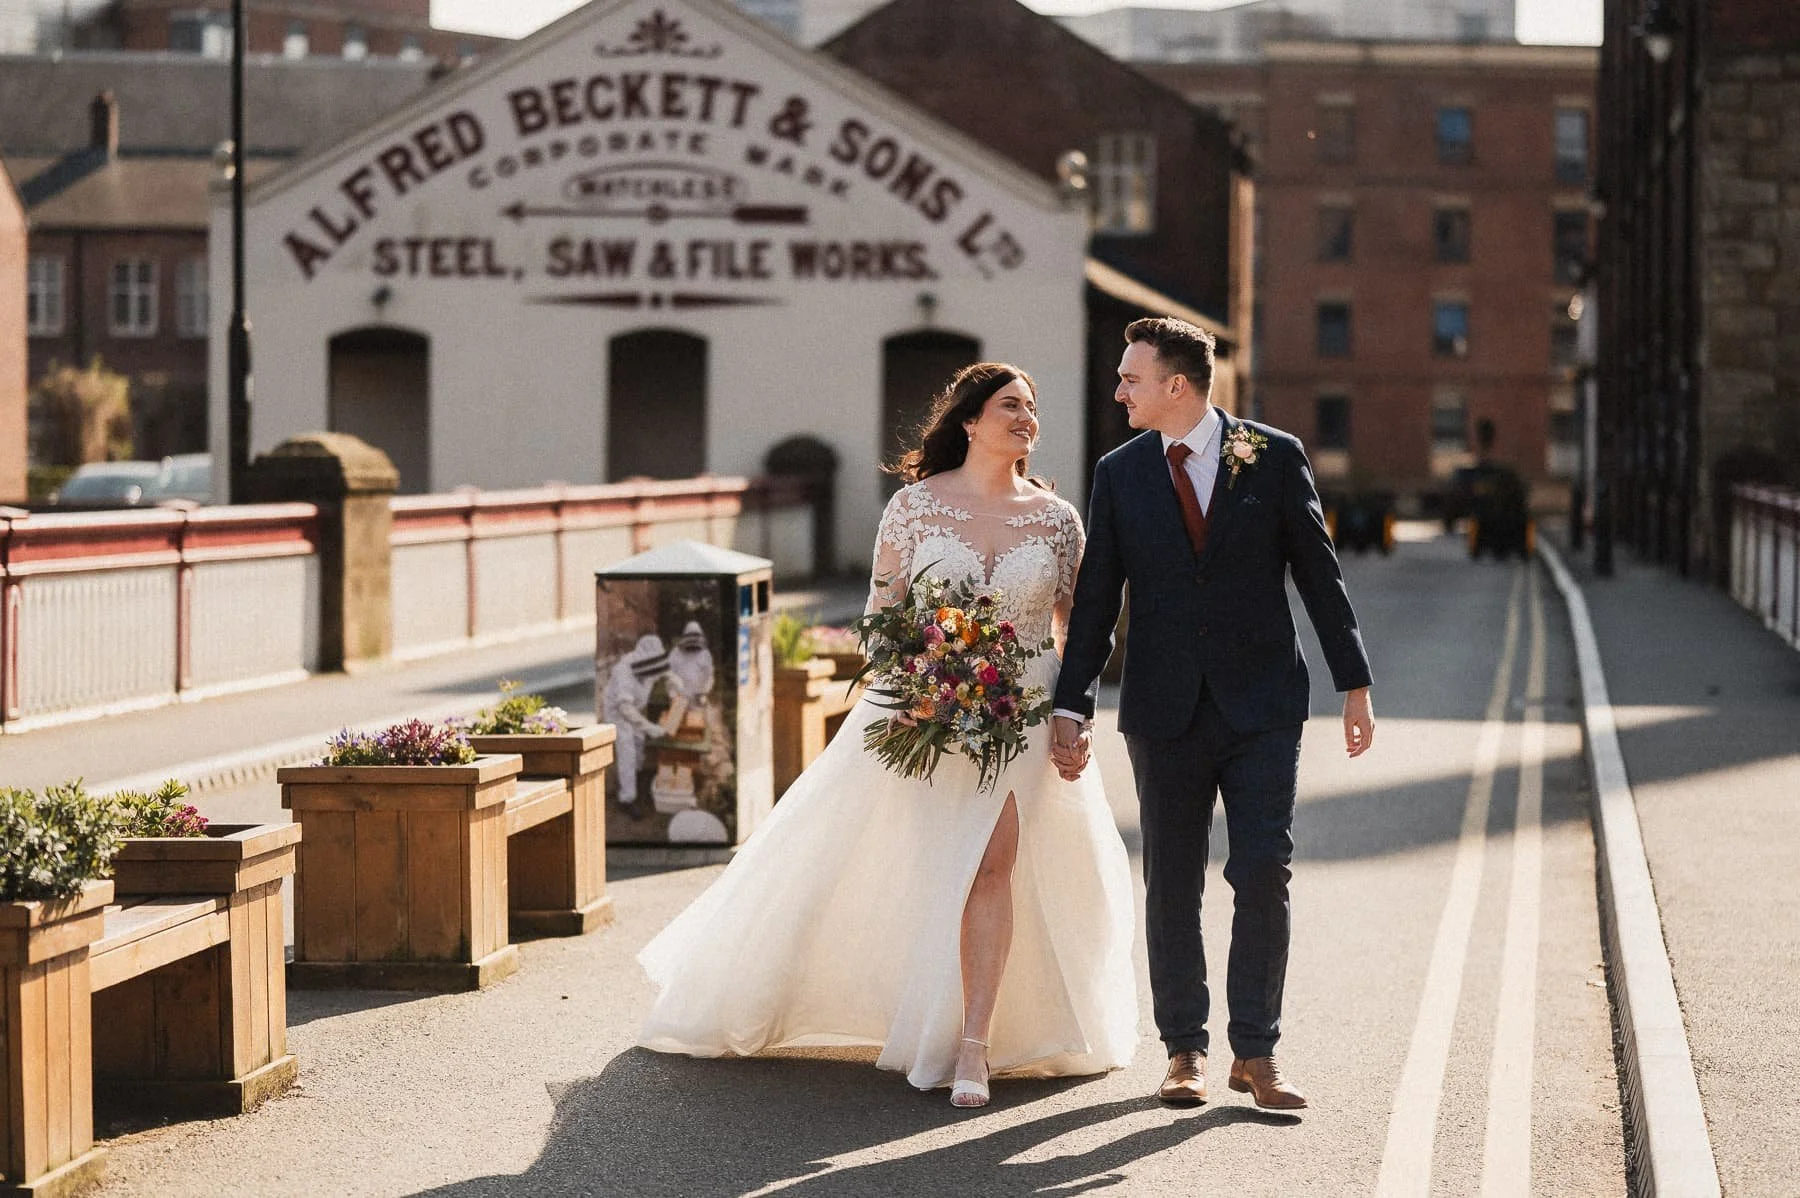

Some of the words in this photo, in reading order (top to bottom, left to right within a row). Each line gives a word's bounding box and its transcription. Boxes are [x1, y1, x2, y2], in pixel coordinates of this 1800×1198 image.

[284, 109, 485, 281] ALFRED
[507, 72, 760, 138] BECKETT
[768, 96, 812, 146] &
[828, 117, 964, 223] SONS
[467, 130, 706, 190] CORPORATE
[373, 236, 524, 282] STEEL,
[545, 236, 636, 278] SAW
[648, 240, 676, 279] &
[685, 240, 773, 280] FILE
